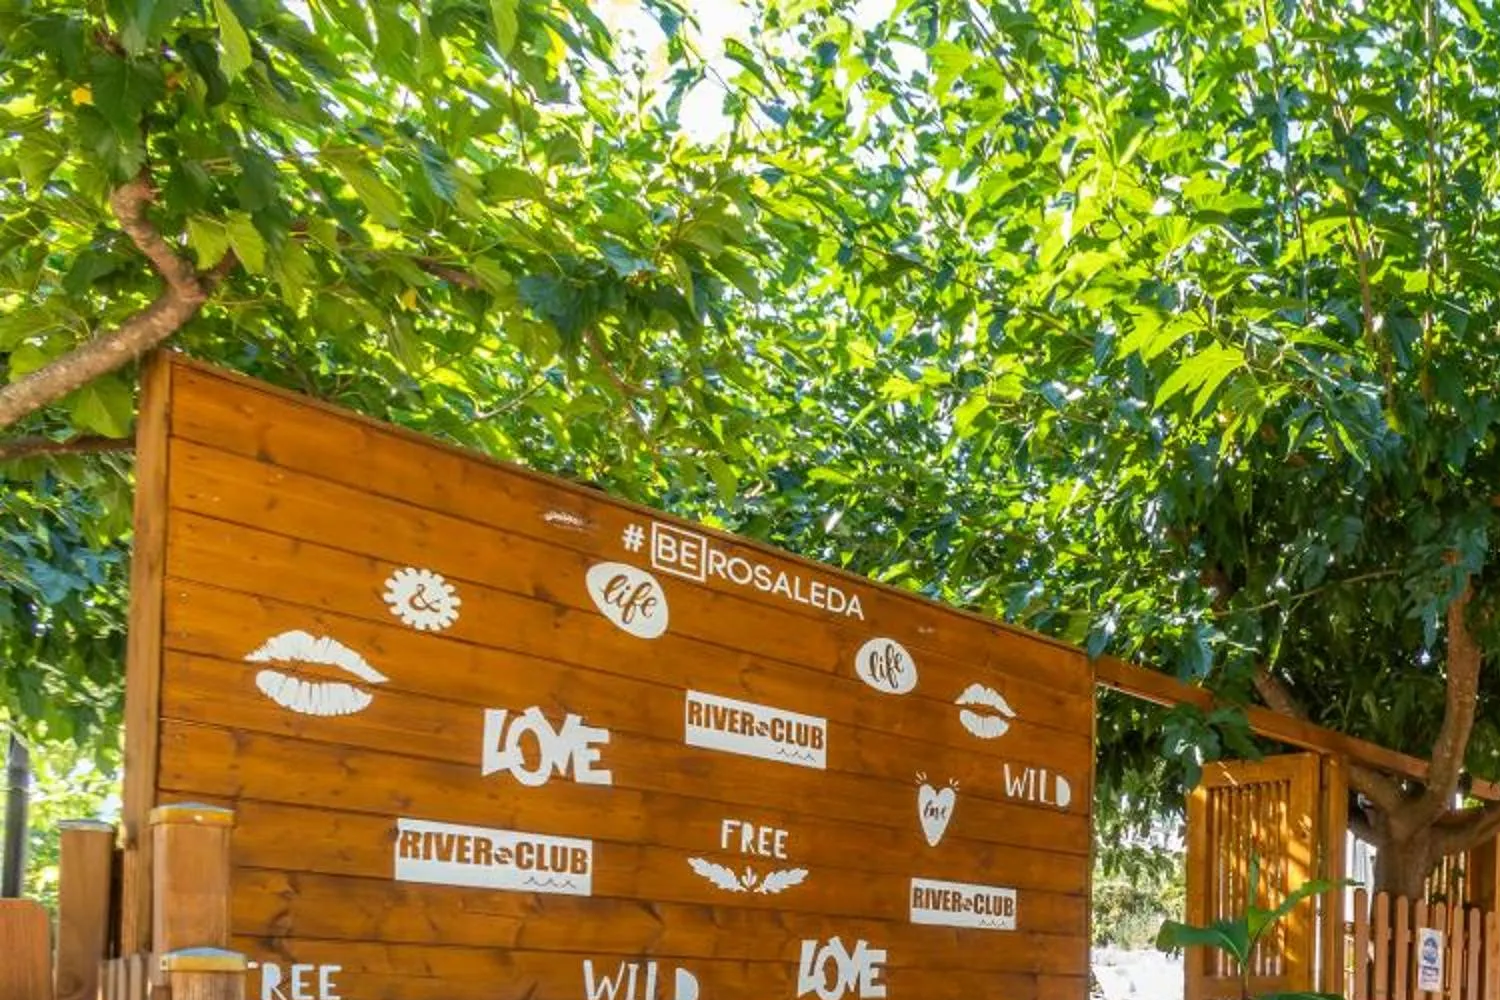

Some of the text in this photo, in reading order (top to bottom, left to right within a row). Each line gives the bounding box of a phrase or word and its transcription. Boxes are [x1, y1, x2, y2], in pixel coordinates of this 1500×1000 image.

[601, 573, 657, 625] life
[708, 549, 865, 622] ROSALEDA
[868, 643, 905, 689] life
[481, 705, 613, 787] LOVE
[687, 699, 825, 750] RIVER CLUB
[1003, 763, 1071, 807] WILD
[399, 829, 588, 875] RIVER CLUB
[720, 818, 789, 860] FREE
[912, 886, 1014, 917] RIVER CLUB
